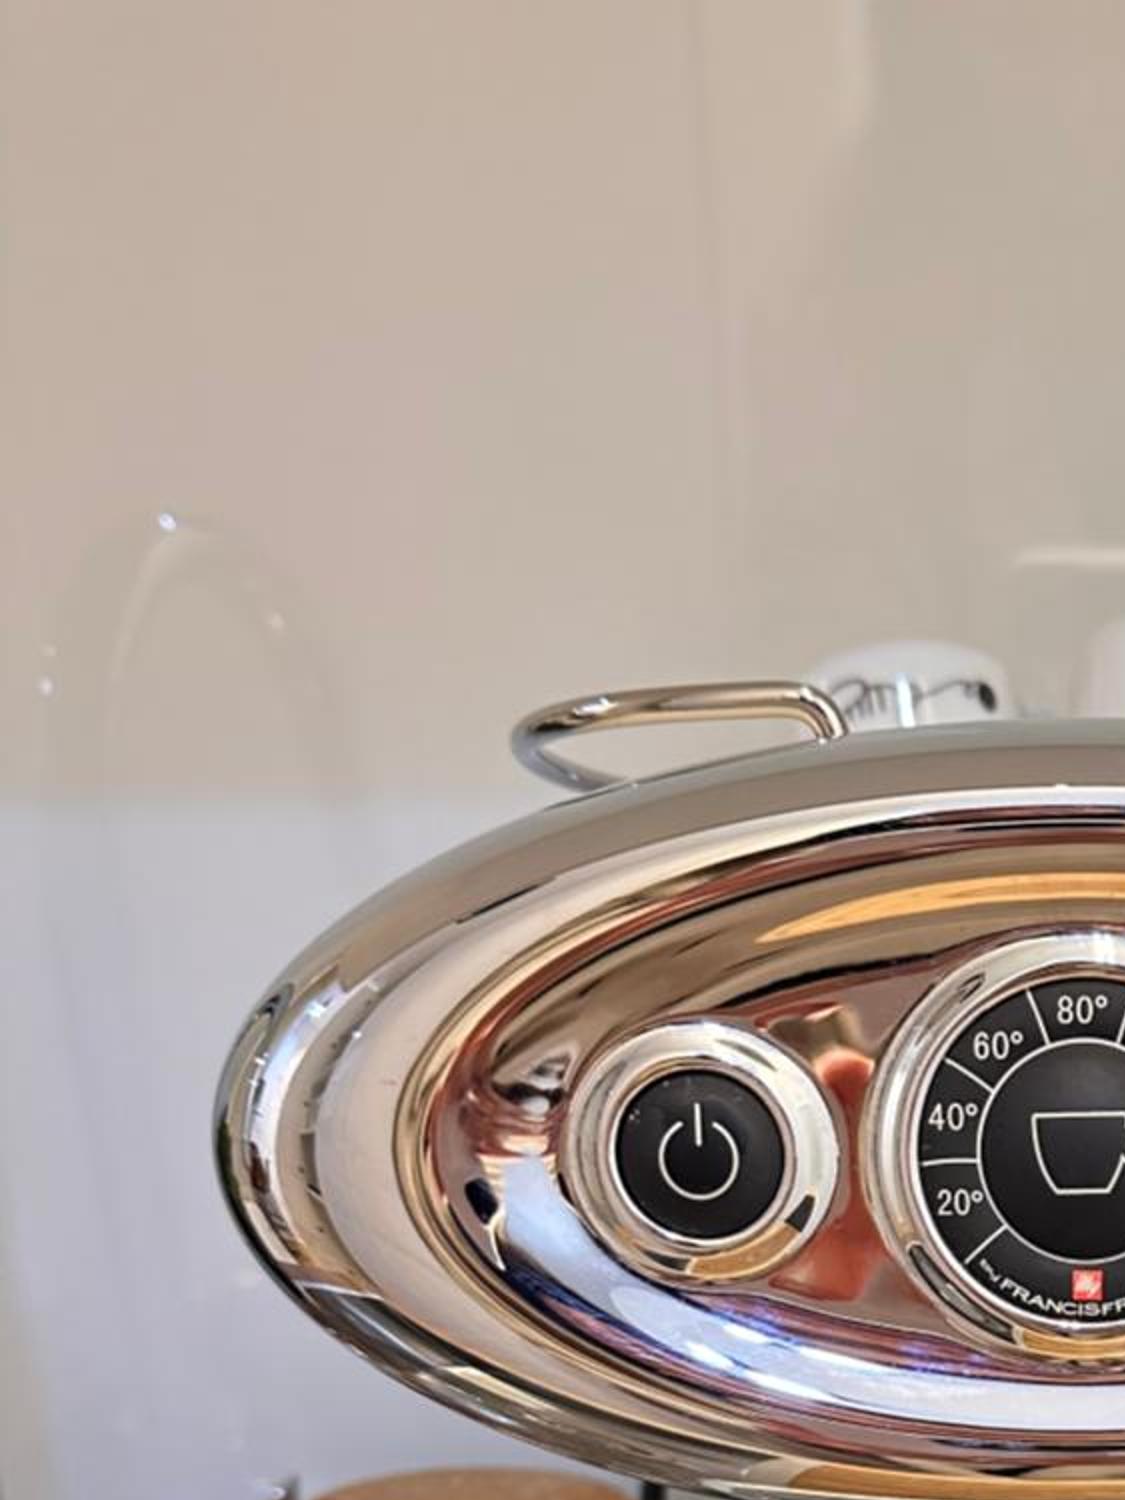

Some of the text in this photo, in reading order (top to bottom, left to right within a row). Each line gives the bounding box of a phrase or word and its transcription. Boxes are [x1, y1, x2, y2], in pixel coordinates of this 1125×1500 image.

[1056, 995, 1108, 1024] 80°
[973, 1030, 1023, 1060] 60°
[928, 1103, 979, 1131] 40°
[937, 1188, 984, 1216] 20°
